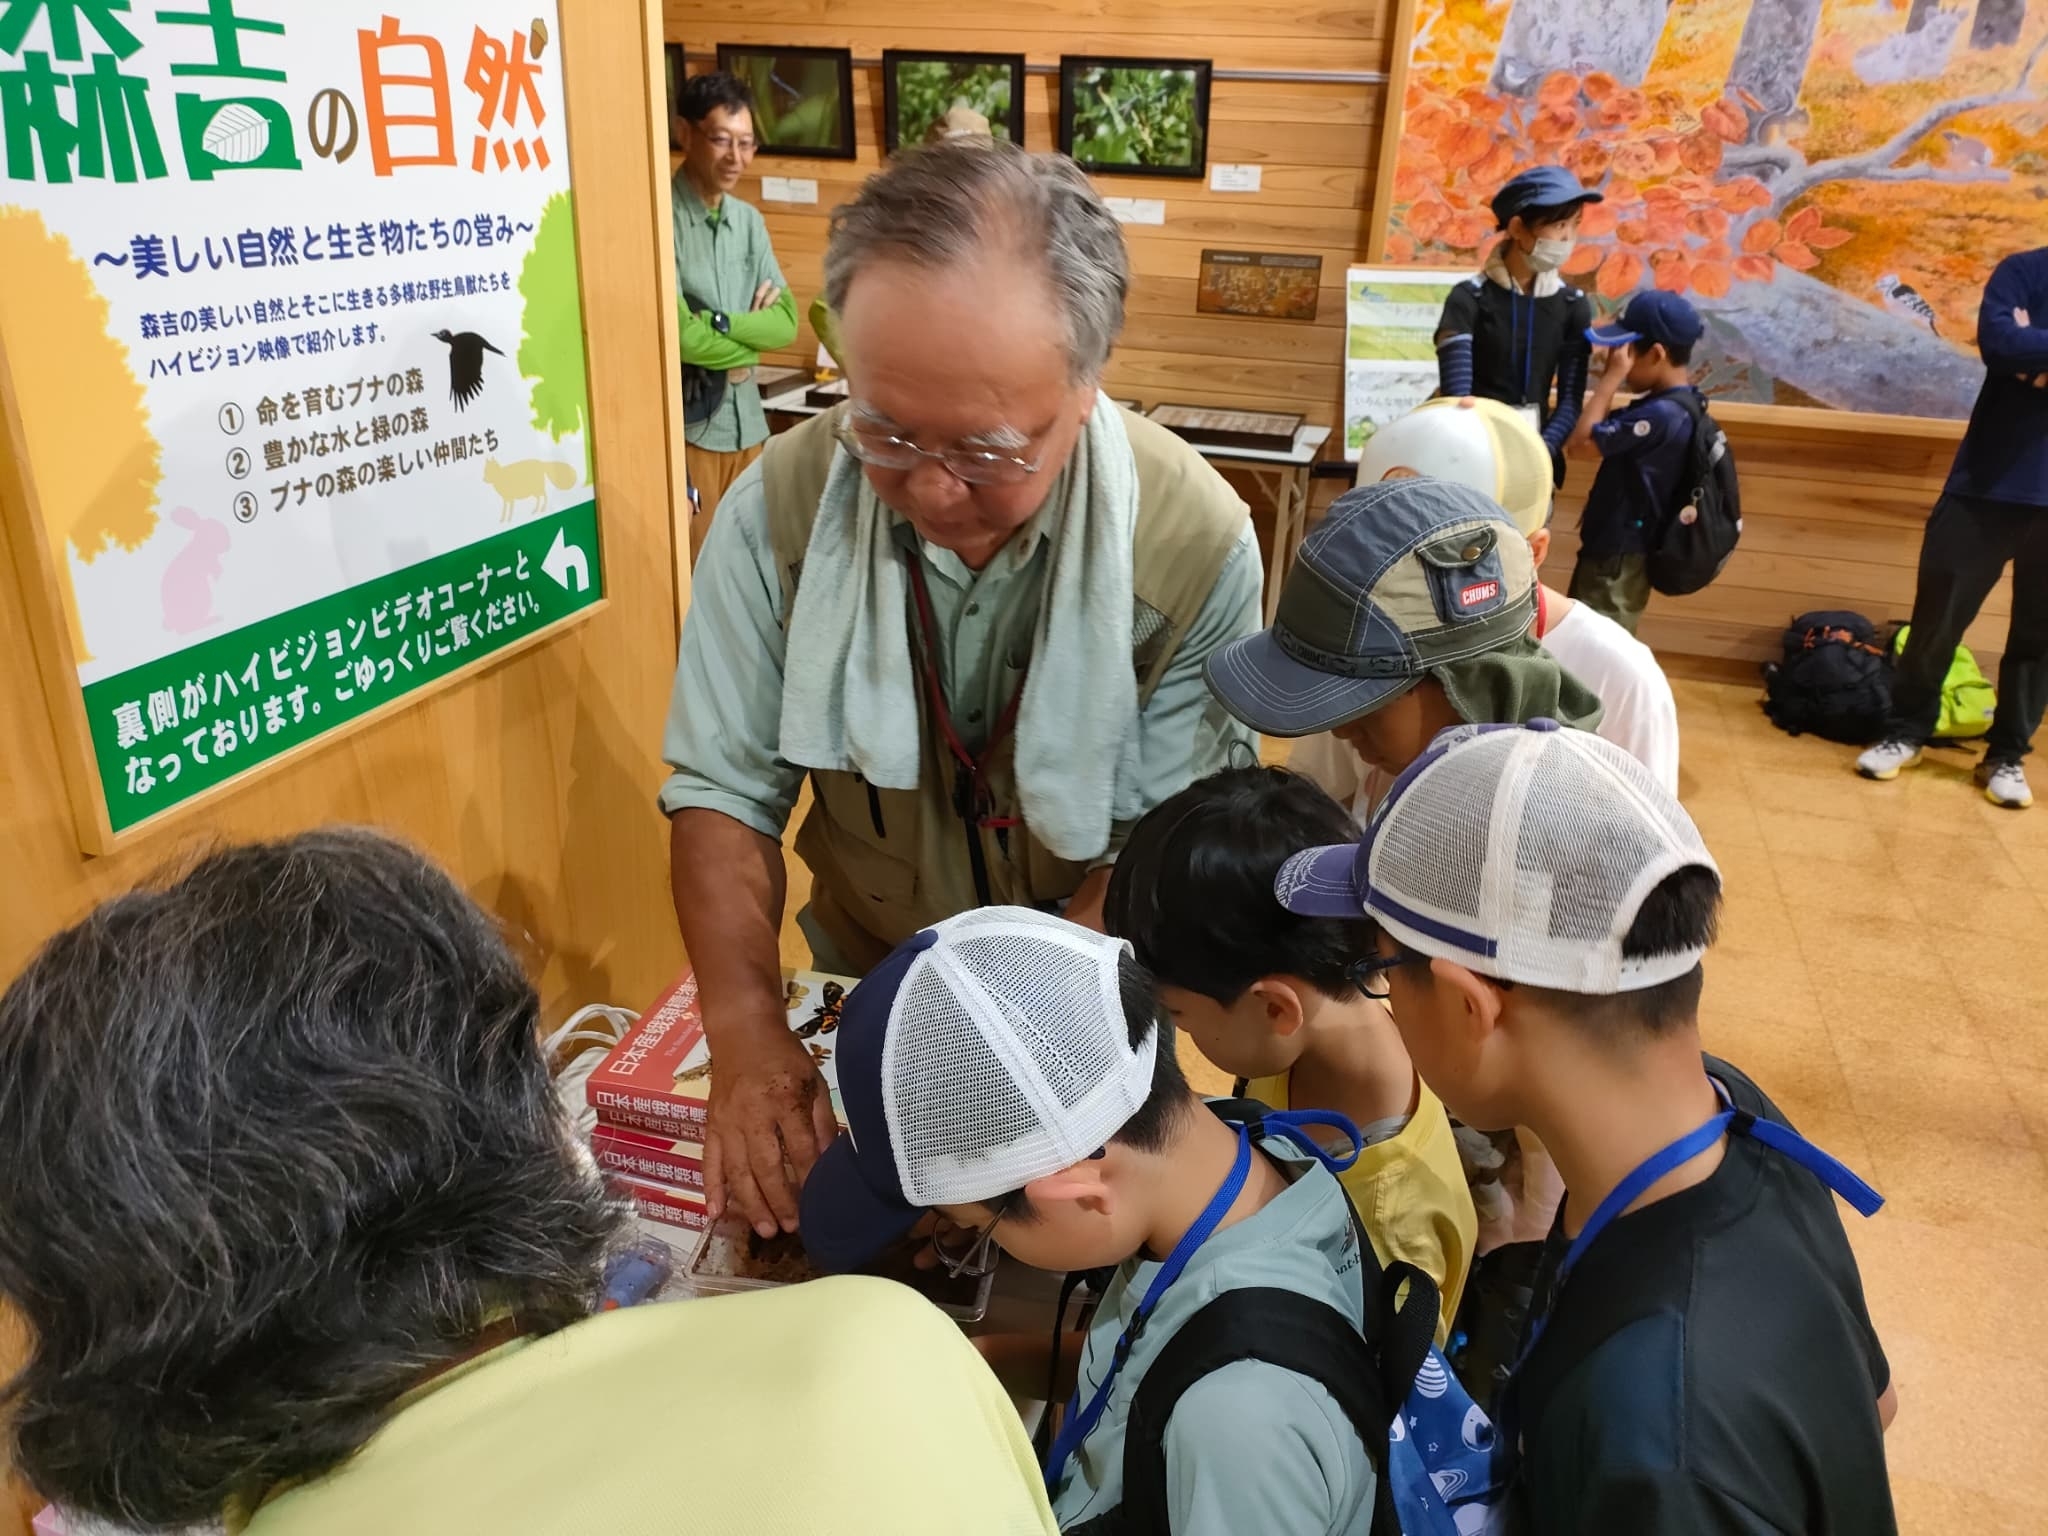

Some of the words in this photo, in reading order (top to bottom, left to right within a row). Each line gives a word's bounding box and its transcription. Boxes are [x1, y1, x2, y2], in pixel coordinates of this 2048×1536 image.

[0, 0, 552, 183] 森吉の自然
[140, 271, 511, 340] 森吉の美しい自然とそこに生きる多様な野生鳥獣たちを
[149, 322, 387, 379] ハイビジョン映像で紹介します。
[256, 367, 425, 427] 命を育むブナの森
[263, 406, 430, 472] 豊かな水と緑の森
[271, 428, 500, 513] ブナの森の楽しい仲間たち
[1462, 583, 1496, 605] CHUMS
[112, 549, 530, 750] 裏側がハイビジョンビデオコーナーと
[124, 590, 540, 795] なっております。ごゆっくりご覧ください。
